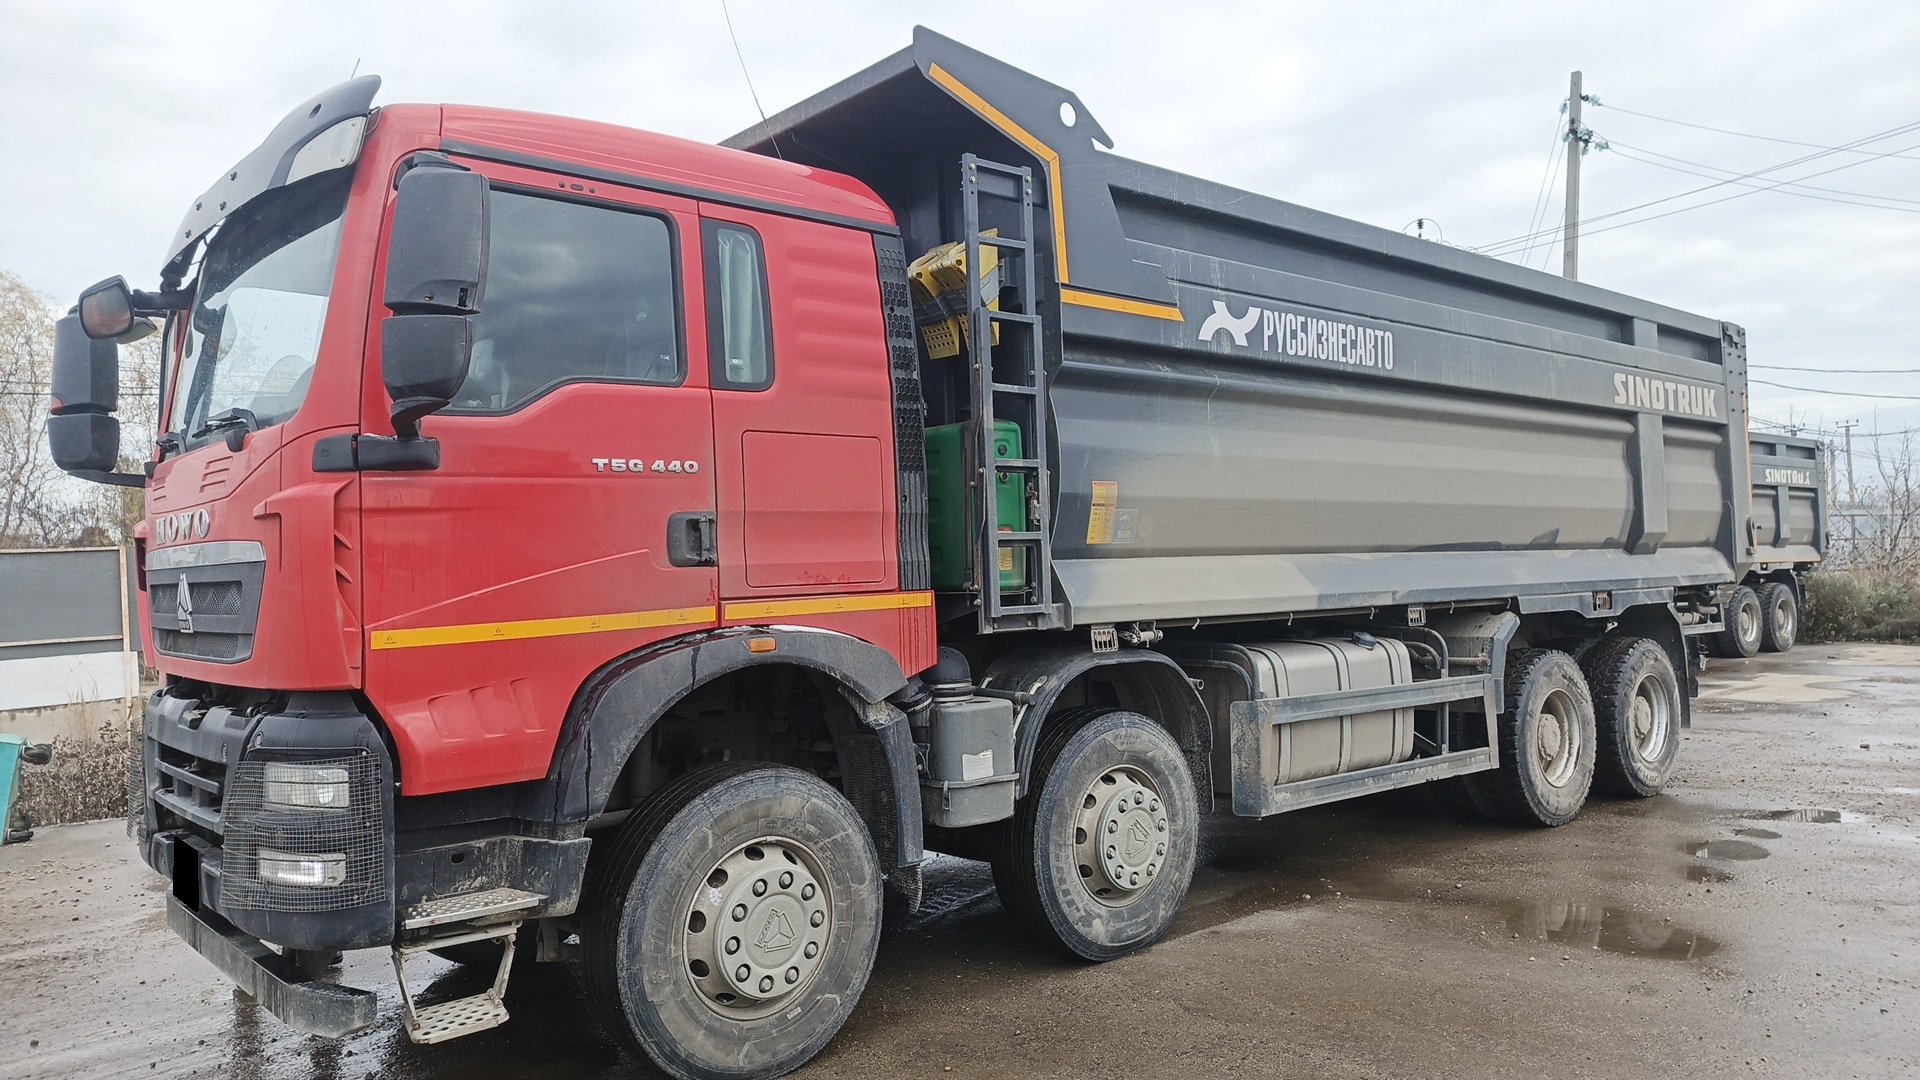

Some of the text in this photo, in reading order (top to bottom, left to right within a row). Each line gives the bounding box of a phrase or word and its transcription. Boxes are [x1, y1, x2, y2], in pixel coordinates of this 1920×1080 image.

[1263, 309, 1394, 370] РУСБИЗНЕСАВТО
[1613, 372, 1718, 418] SINOTRUK
[592, 458, 699, 474] T5G 440
[156, 508, 210, 545] HOWO
